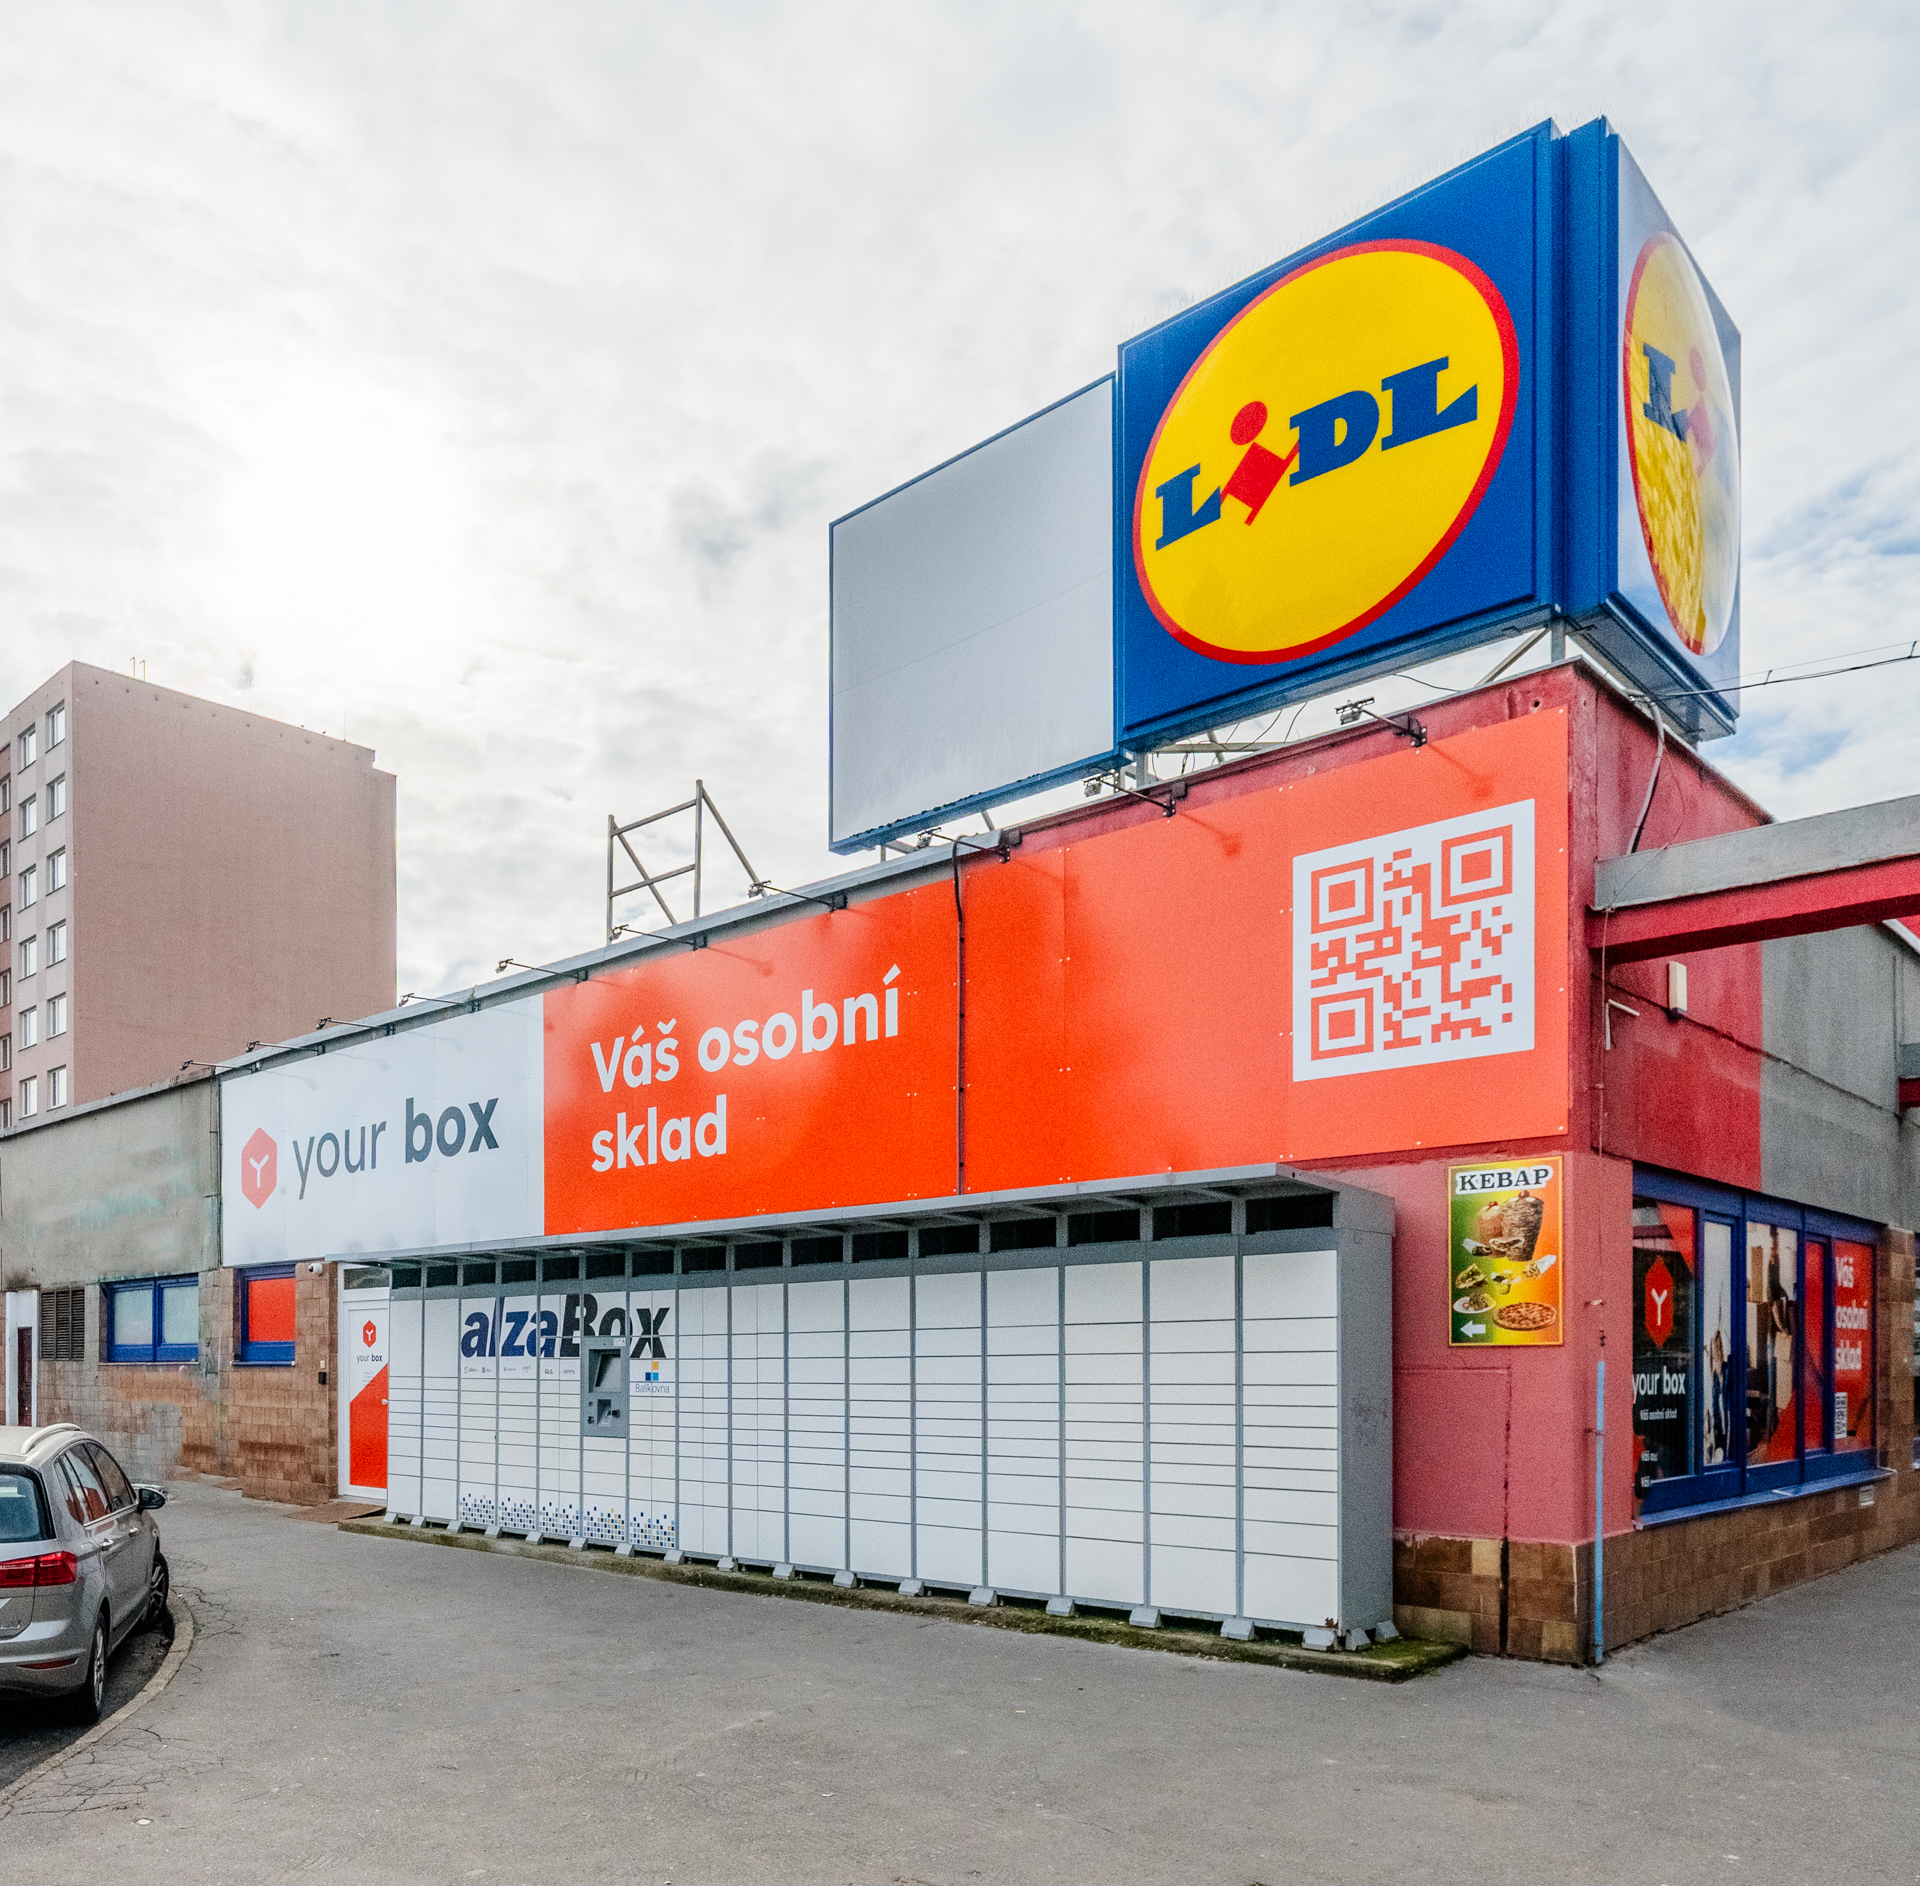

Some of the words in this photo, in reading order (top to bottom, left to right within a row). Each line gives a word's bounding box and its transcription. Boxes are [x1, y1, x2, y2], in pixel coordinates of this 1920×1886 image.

[590, 1018, 680, 1093] Váš
[697, 963, 901, 1073] osobní
[292, 1120, 387, 1200] your
[404, 1097, 500, 1163] box
[591, 1093, 727, 1172] sklad
[1459, 1168, 1549, 1191] KEBAP
[356, 1354, 370, 1364] your
[371, 1353, 383, 1362] box
[461, 1293, 671, 1359] alzaBox
[1632, 1373, 1660, 1404] your
[1662, 1365, 1686, 1394] box
